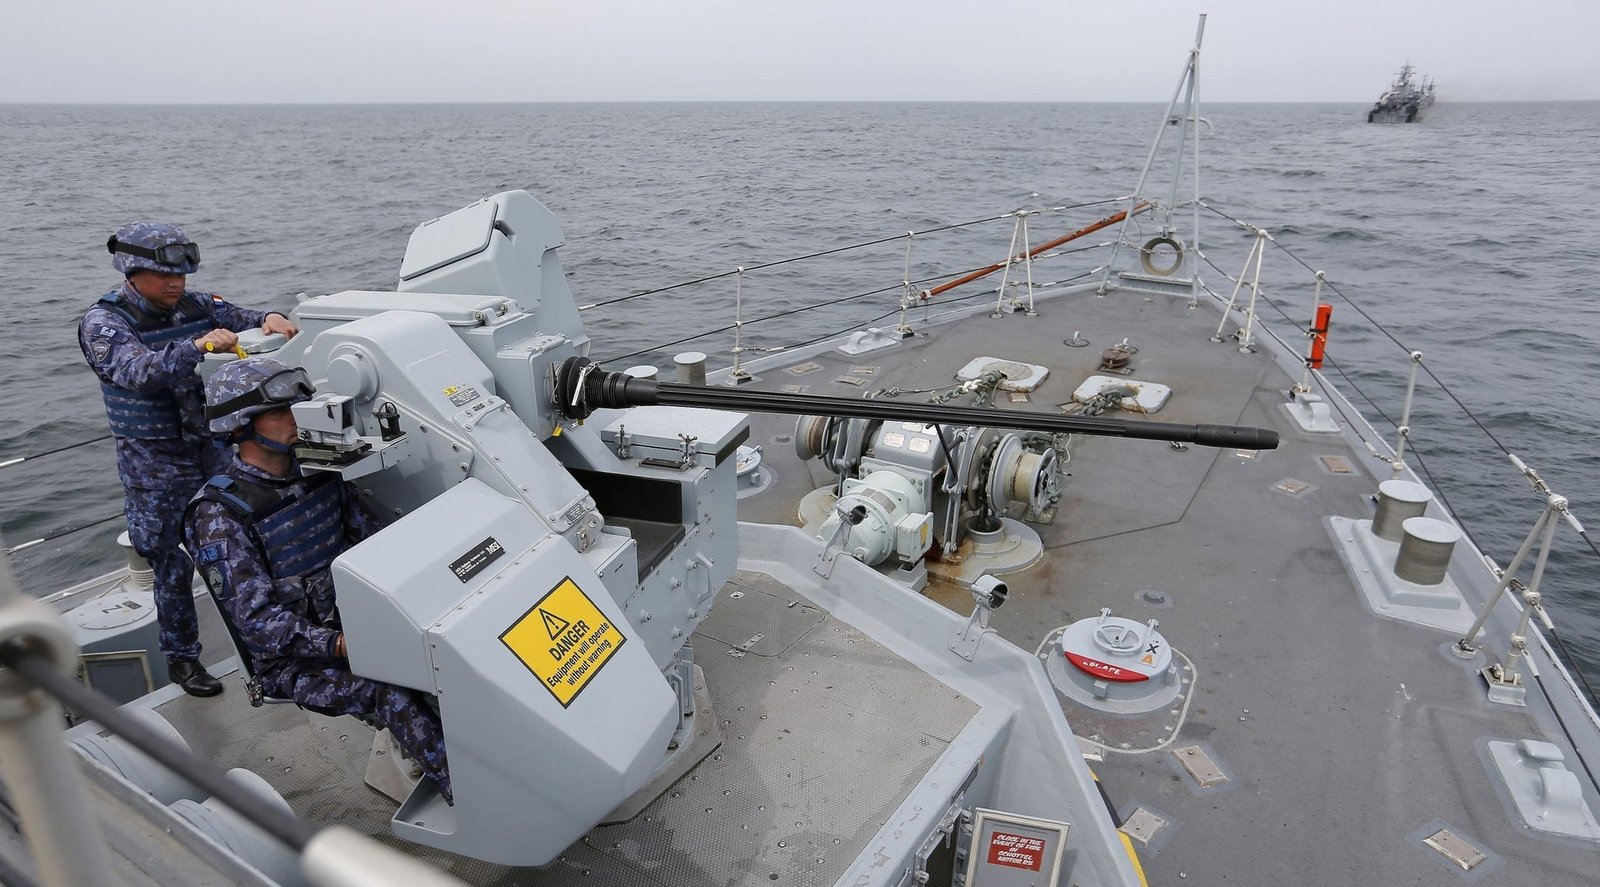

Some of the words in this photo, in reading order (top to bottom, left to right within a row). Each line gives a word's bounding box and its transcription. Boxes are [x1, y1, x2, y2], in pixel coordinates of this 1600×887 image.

[546, 651, 581, 688] Equipment
[579, 640, 591, 655] will
[588, 622, 610, 647] operate
[548, 619, 591, 662] DANGER
[566, 660, 591, 686] without
[587, 638, 612, 664] warning
[998, 851, 1032, 860] SCHOTTEL
